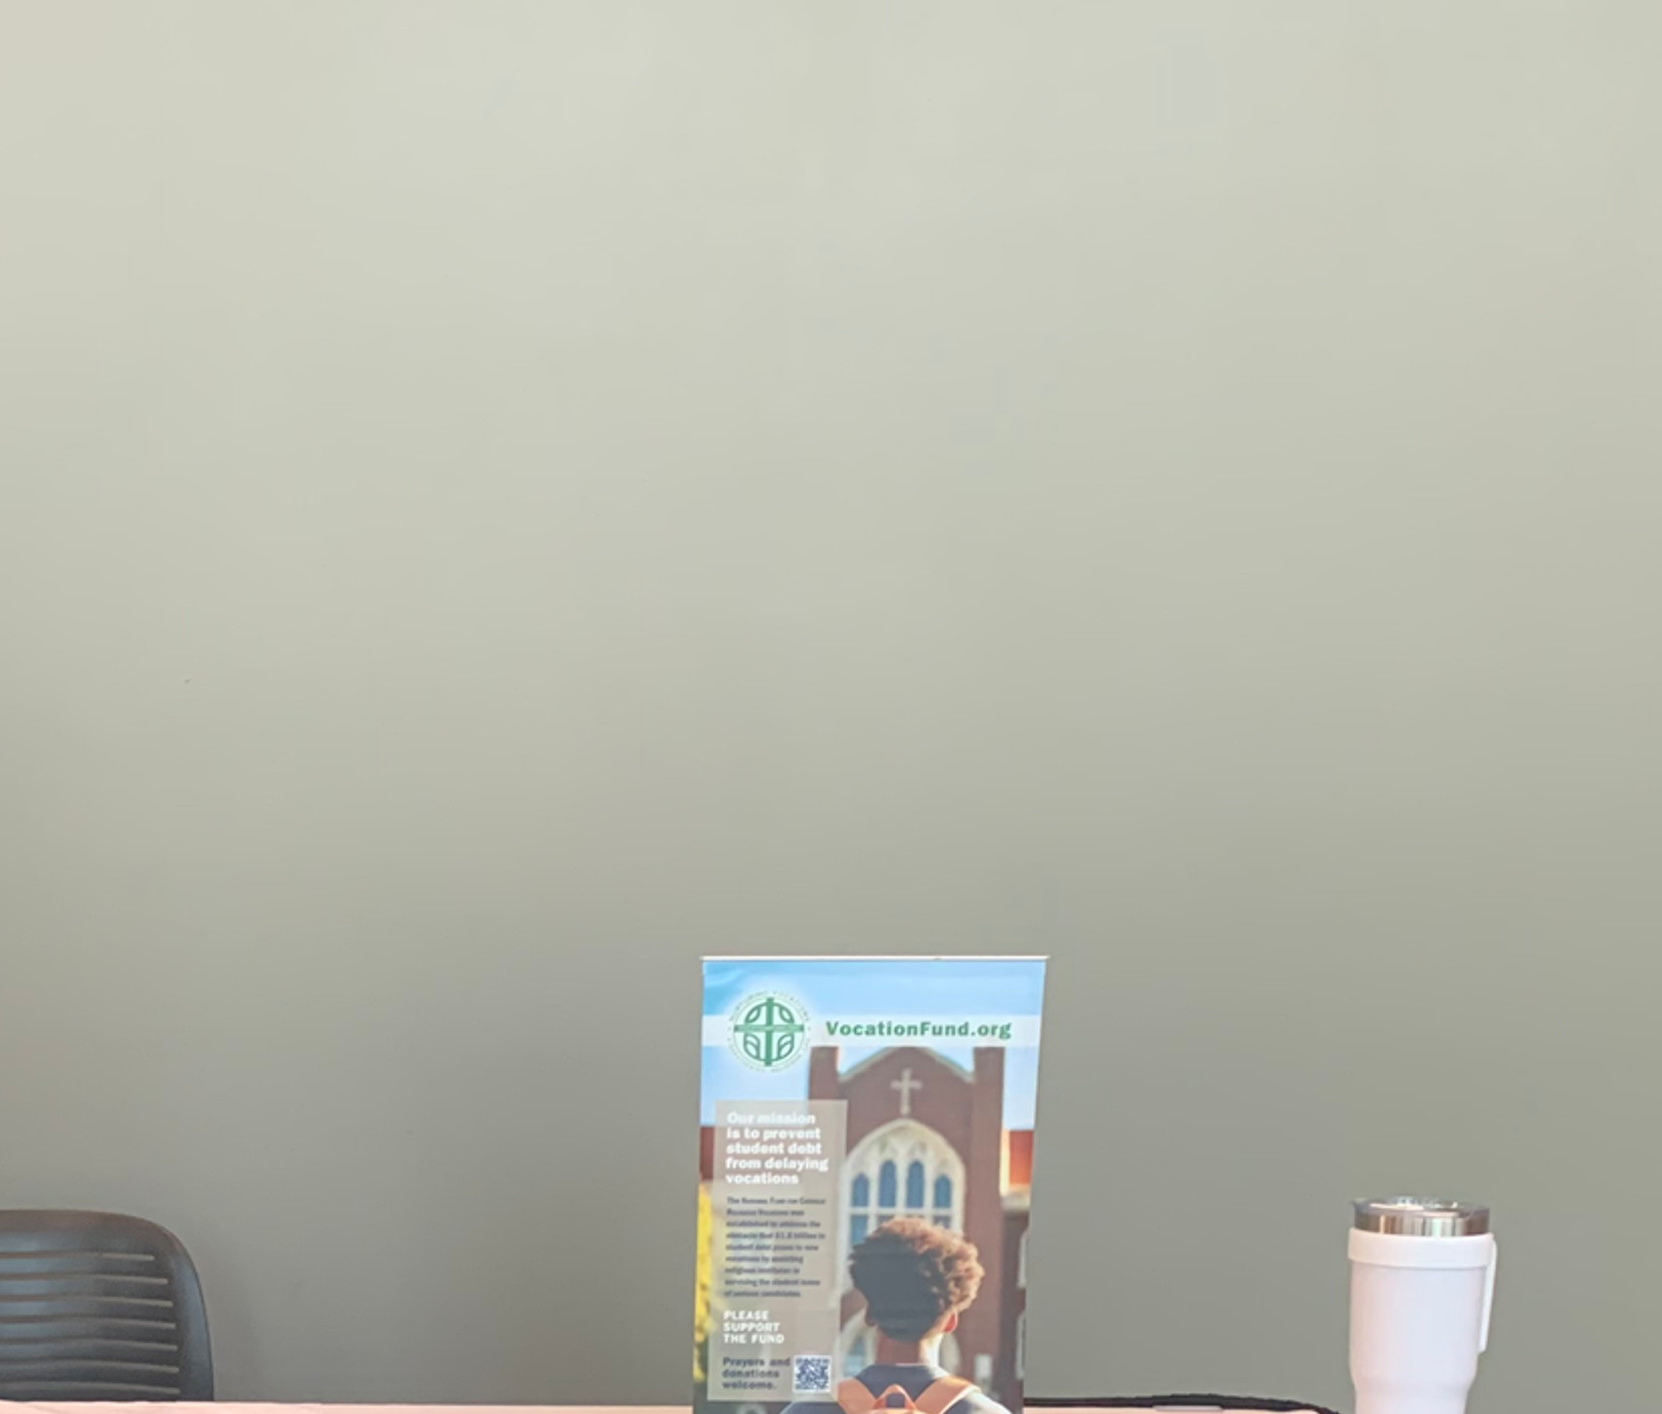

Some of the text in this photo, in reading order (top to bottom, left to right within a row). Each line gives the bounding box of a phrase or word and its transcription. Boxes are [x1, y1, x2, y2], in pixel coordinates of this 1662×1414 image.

[826, 1022, 1012, 1039] VocationFund.org
[727, 1111, 816, 1124] Our mission
[727, 1128, 821, 1141] is to prevent
[726, 1142, 821, 1154] student debt
[726, 1157, 829, 1172] from delaying
[726, 1172, 799, 1184] vocations
[723, 1310, 769, 1321] PLEASE
[723, 1322, 780, 1332] SUPPORT
[723, 1334, 784, 1344] THE FUND
[723, 1357, 790, 1368] Prayers and
[722, 1369, 780, 1378] donations
[722, 1381, 777, 1390] welcome.
